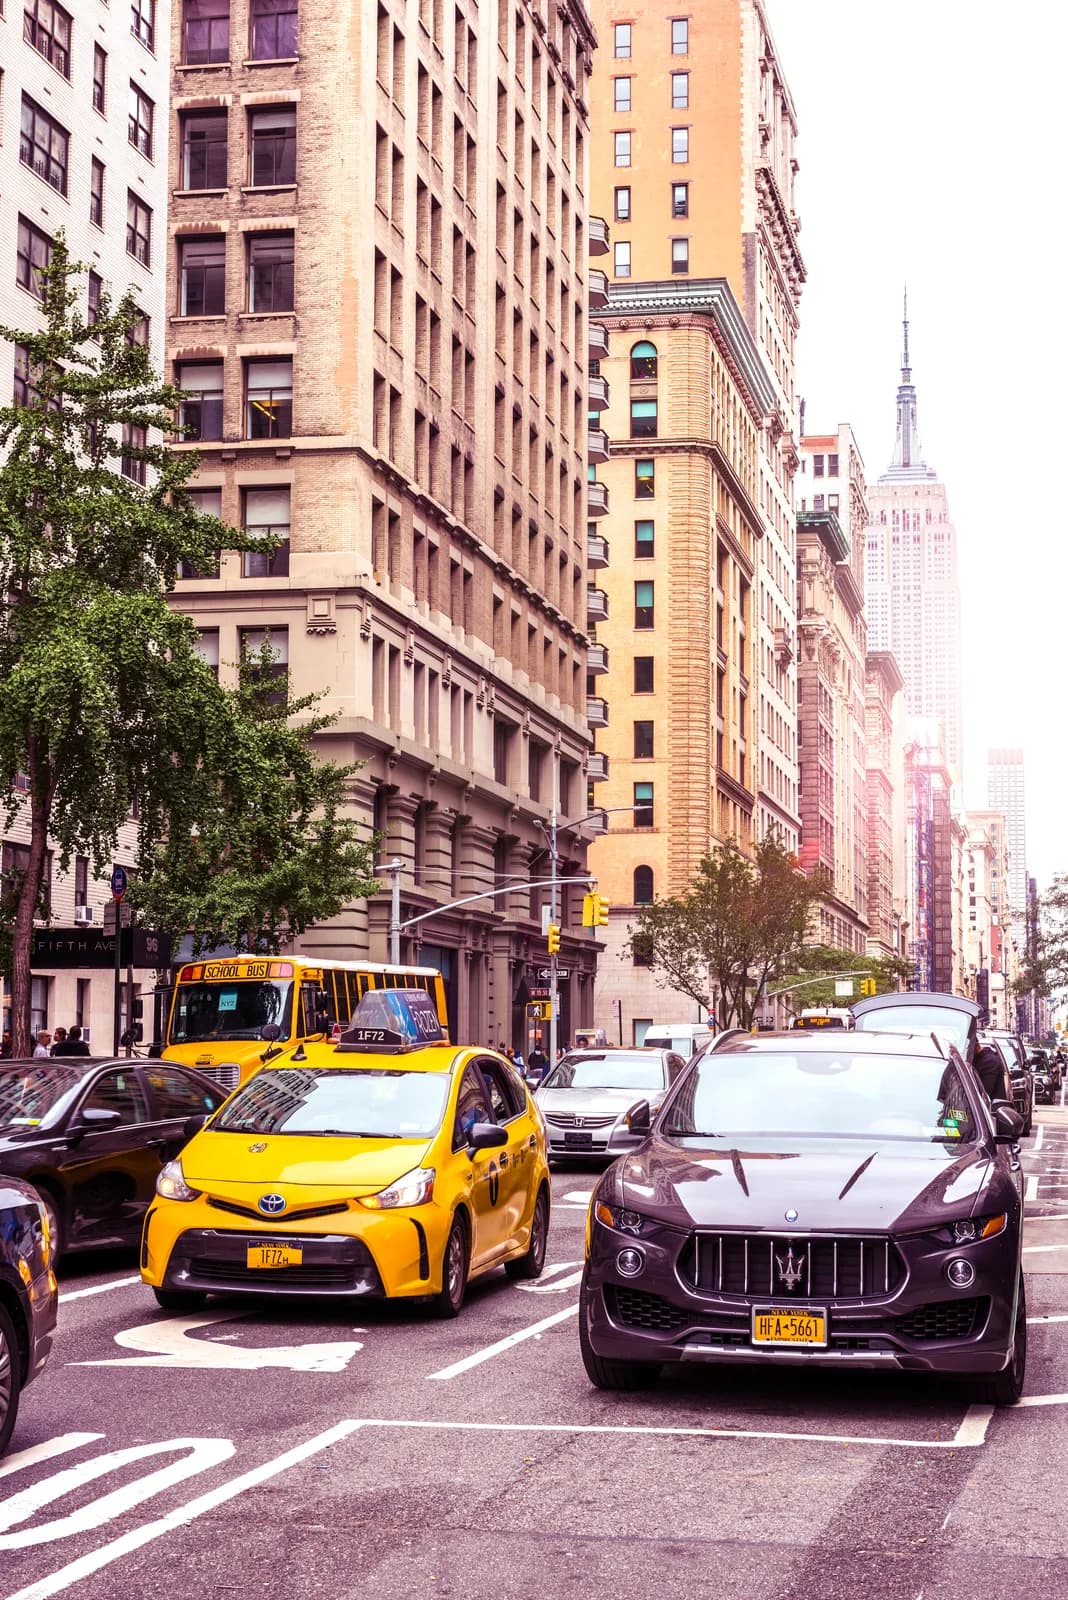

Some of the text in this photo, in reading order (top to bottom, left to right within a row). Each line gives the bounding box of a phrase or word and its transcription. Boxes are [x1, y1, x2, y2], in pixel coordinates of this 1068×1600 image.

[38, 941, 87, 951] FIFTH
[205, 965, 265, 978] SCHOOL BUS
[408, 1005, 440, 1040] FROZEN
[357, 1030, 385, 1041] 1F72
